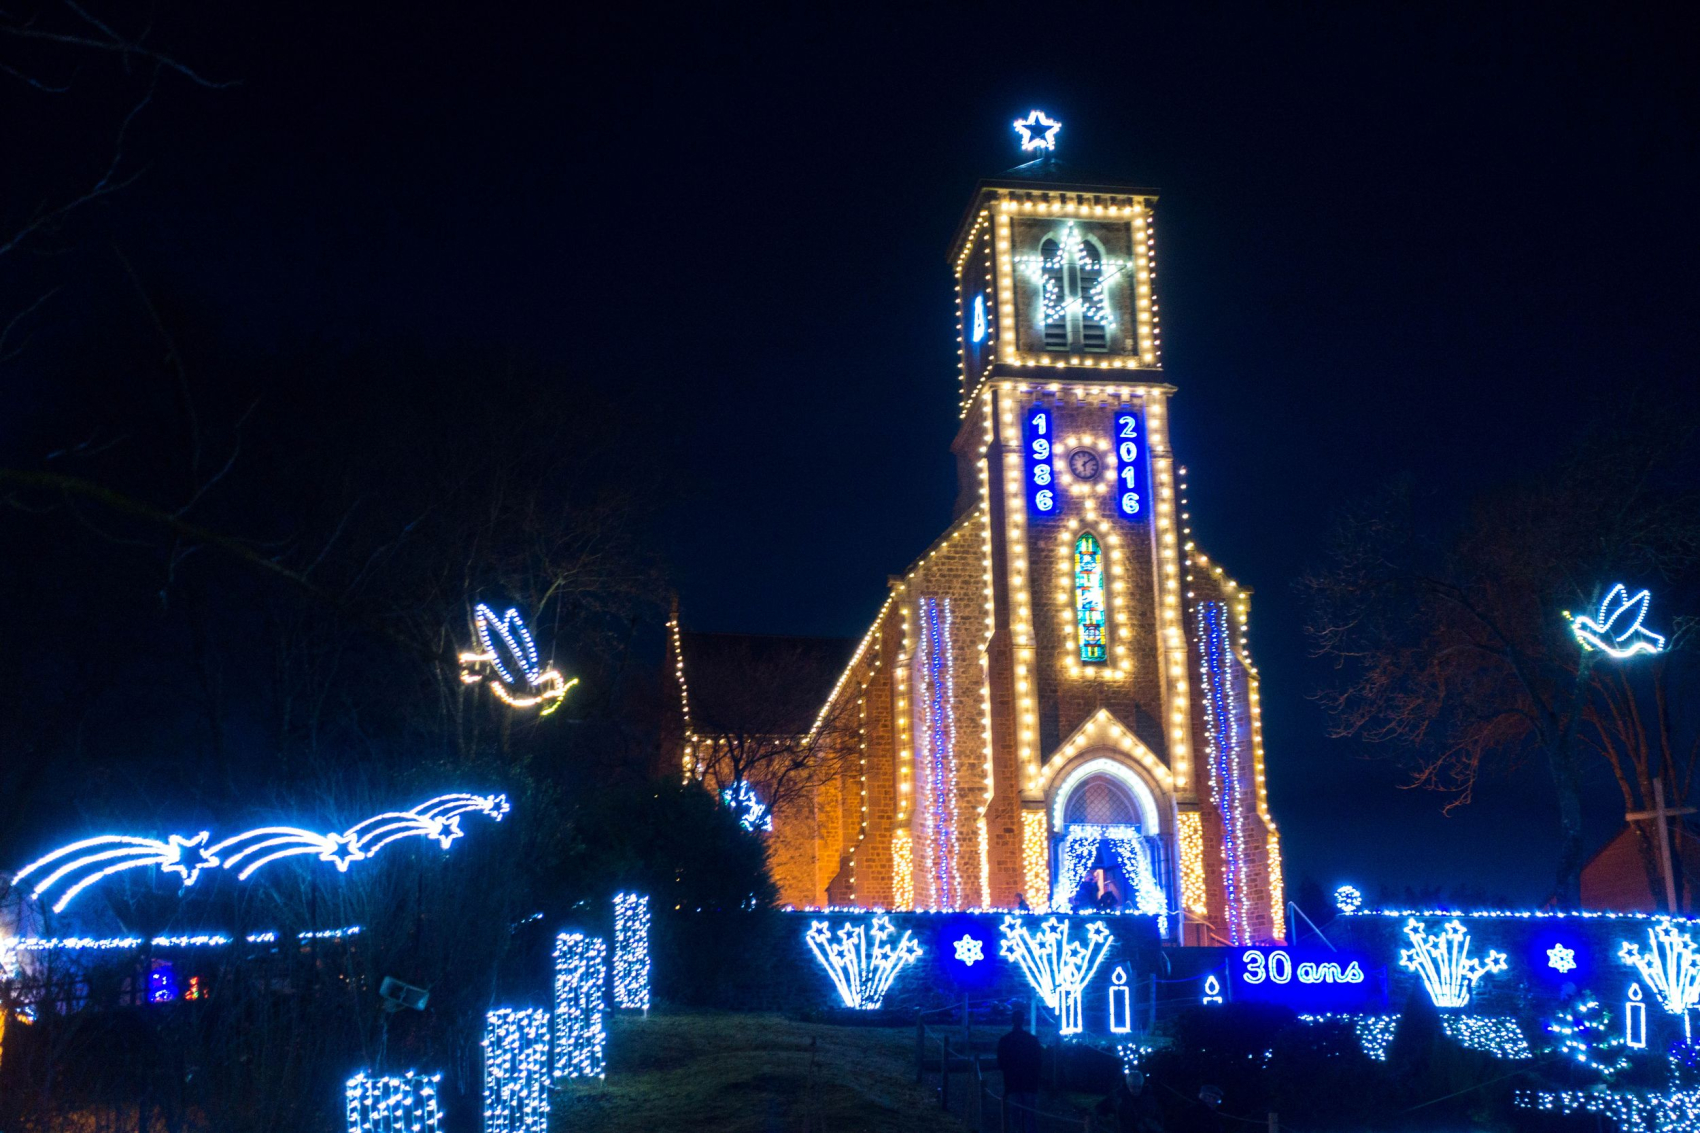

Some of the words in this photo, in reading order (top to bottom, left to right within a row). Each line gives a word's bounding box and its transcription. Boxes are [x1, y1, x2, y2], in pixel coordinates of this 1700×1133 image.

[1032, 413, 1053, 511] 1986
[1119, 416, 1140, 514] 2016
[1242, 950, 1292, 984] 30
[1297, 961, 1364, 984] ans
